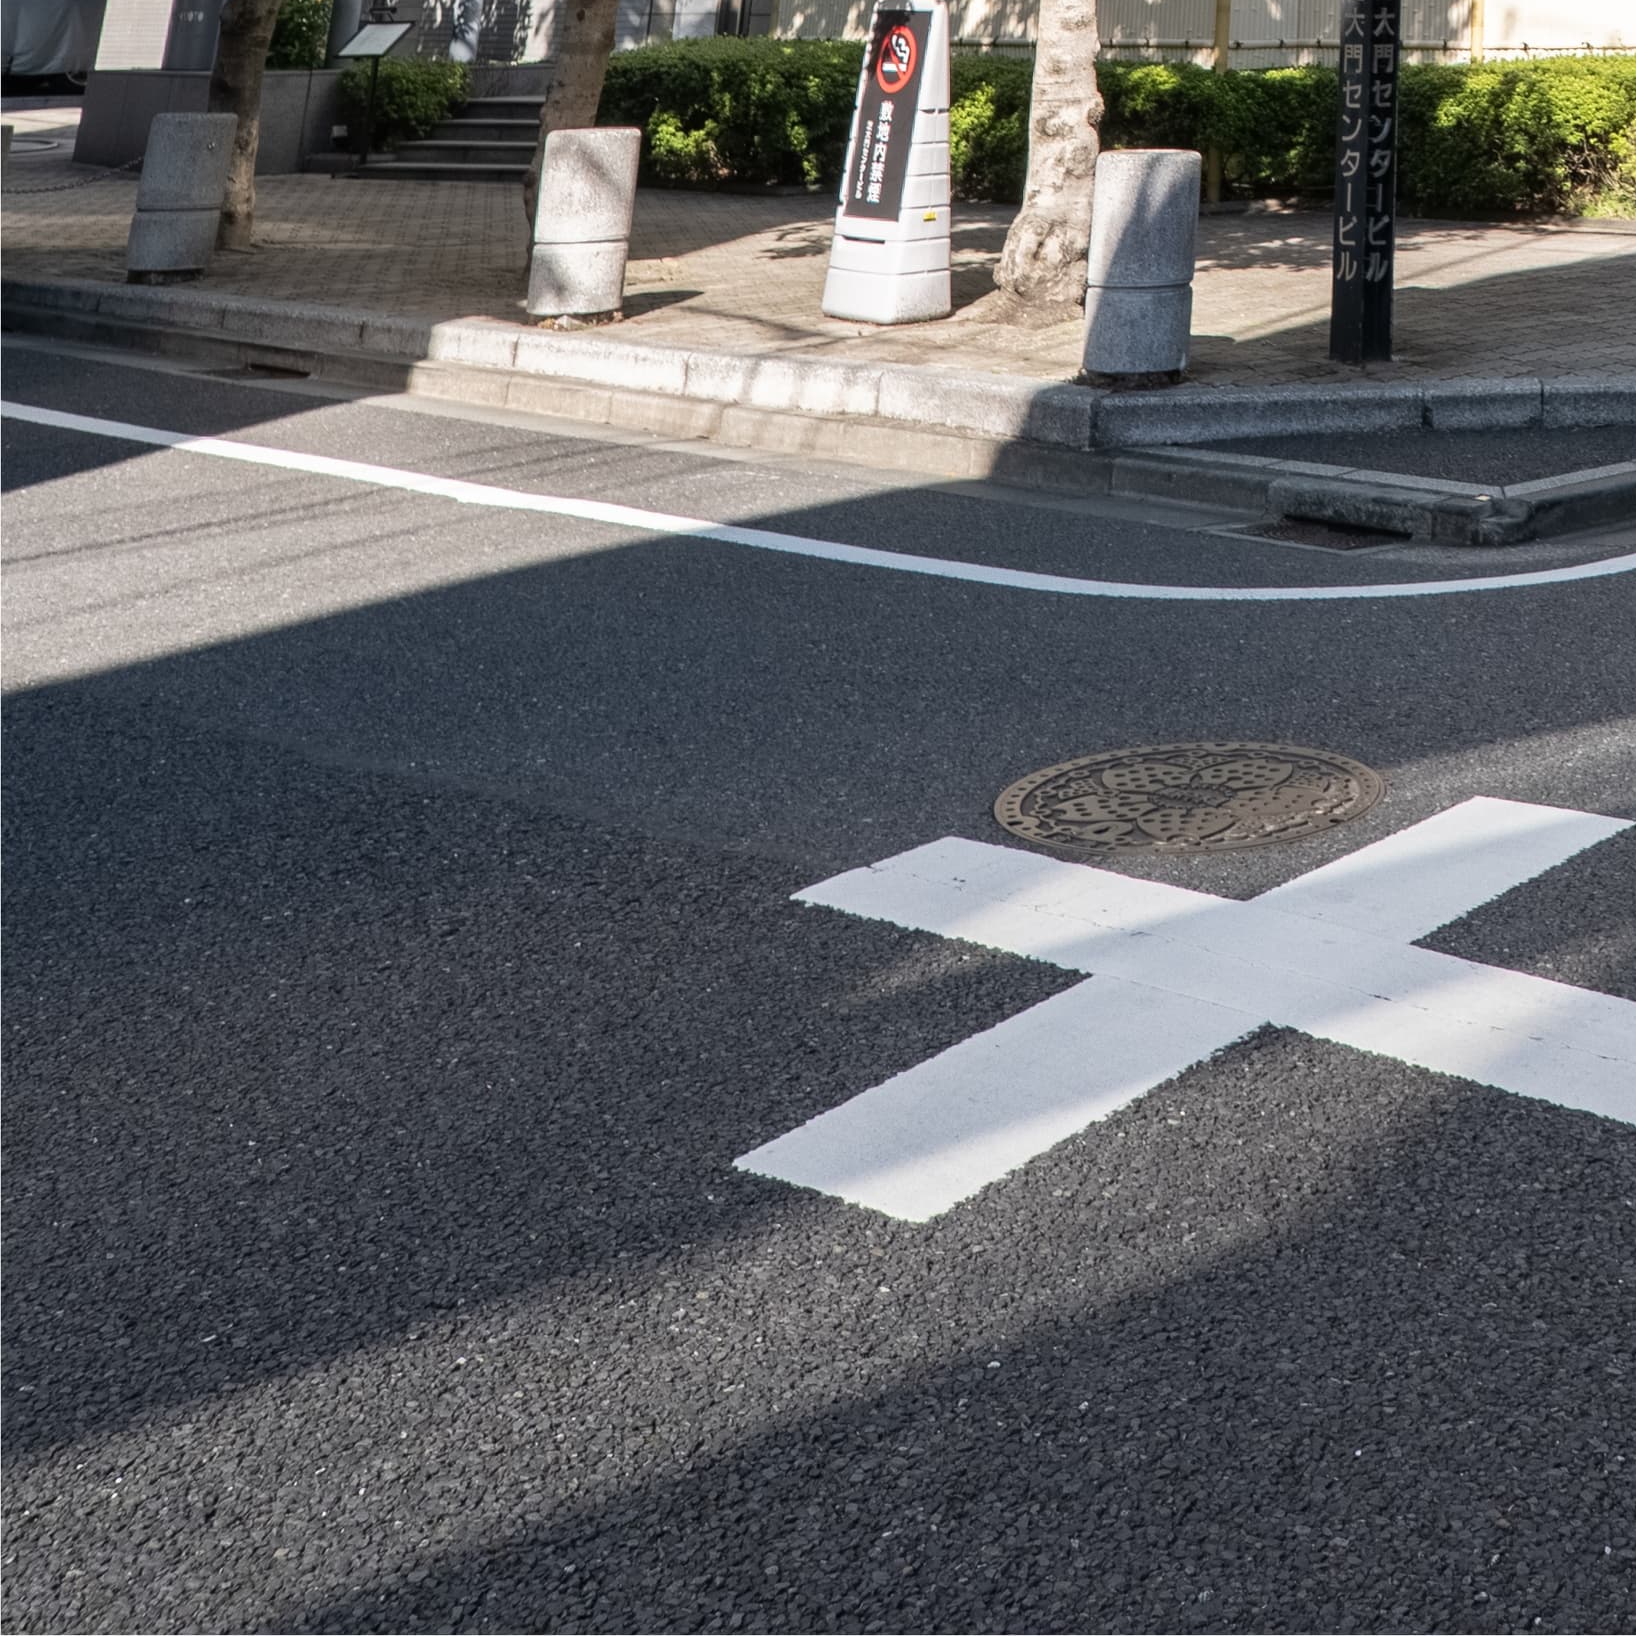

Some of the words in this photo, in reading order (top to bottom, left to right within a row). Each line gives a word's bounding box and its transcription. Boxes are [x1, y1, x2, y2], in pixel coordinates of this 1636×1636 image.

[866, 99, 896, 204] 敷地内禁煙
